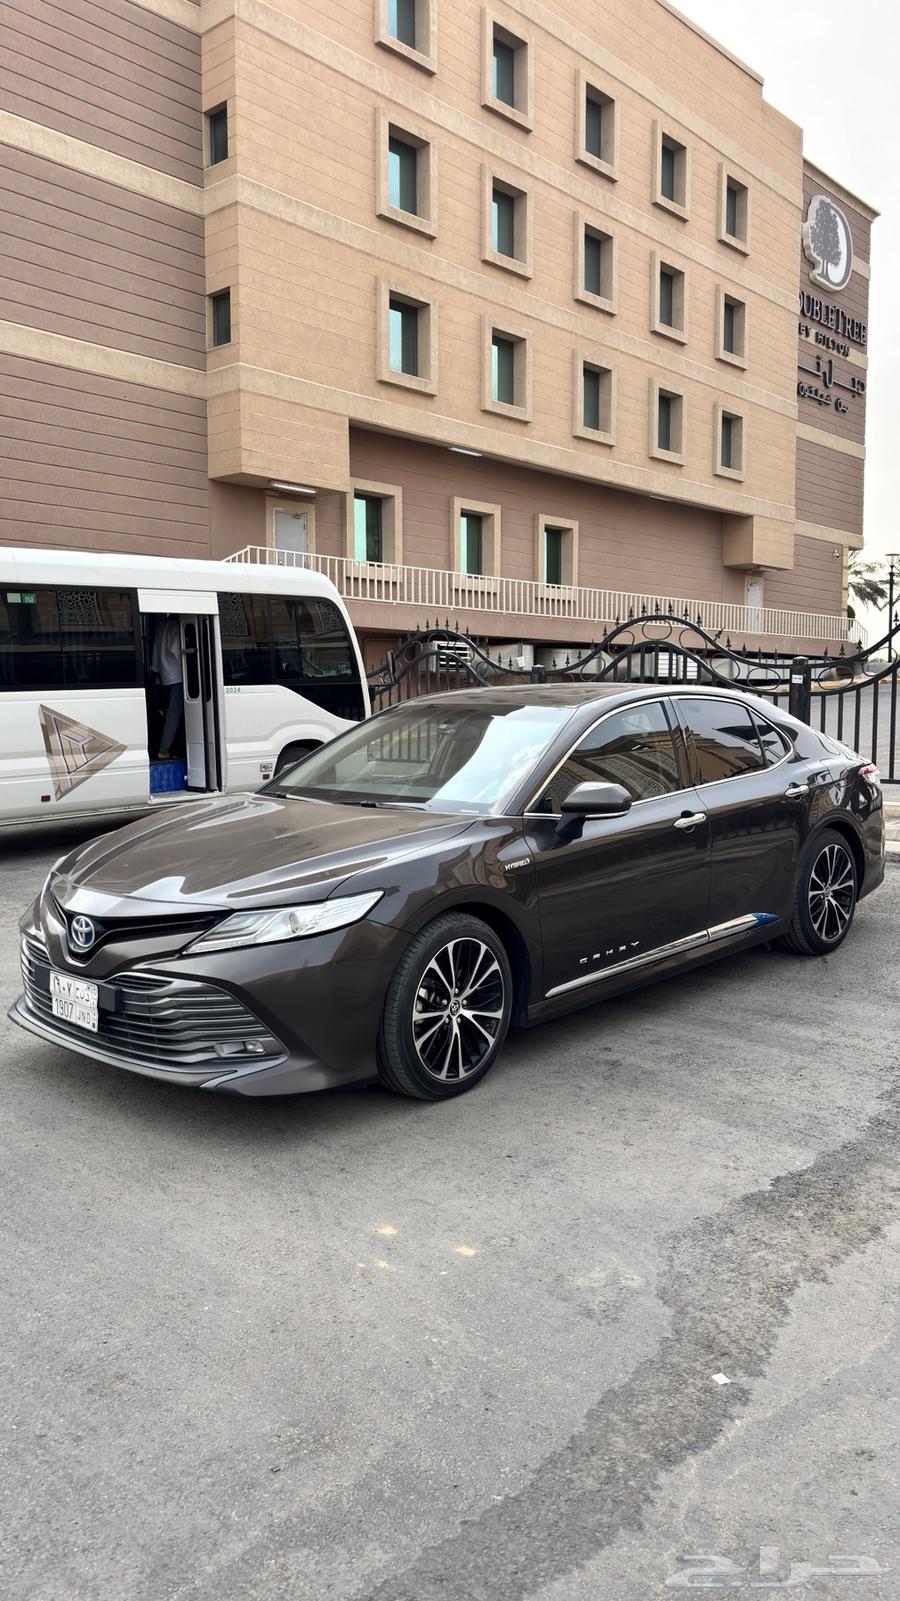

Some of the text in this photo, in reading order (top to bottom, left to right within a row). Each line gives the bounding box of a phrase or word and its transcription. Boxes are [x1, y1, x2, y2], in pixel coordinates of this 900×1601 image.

[815, 331, 850, 357] HILTON
[504, 857, 531, 871] HYBRID
[579, 941, 639, 964] CAMRY
[55, 998, 74, 1019] 1907
